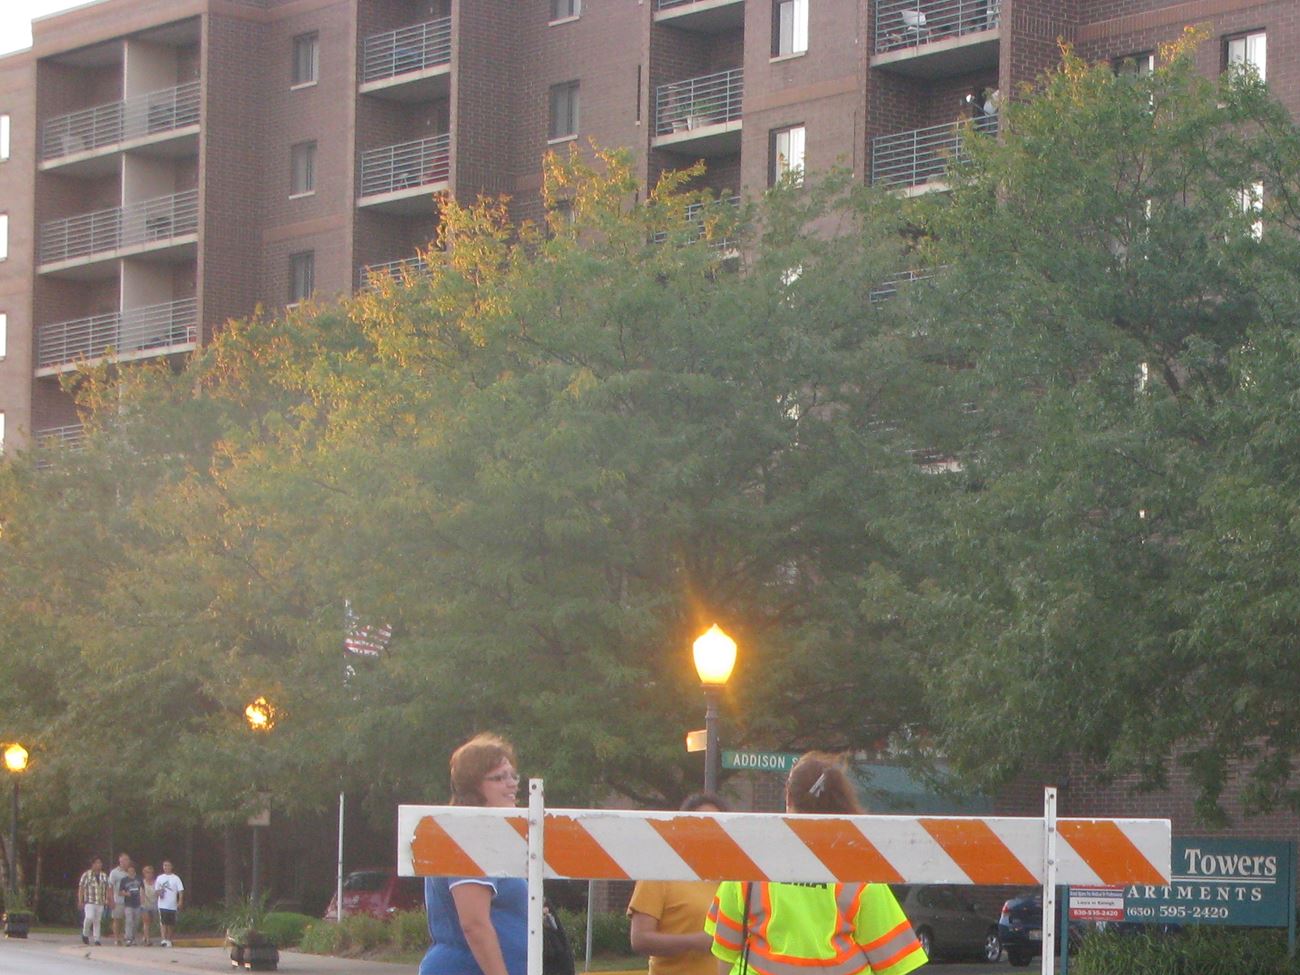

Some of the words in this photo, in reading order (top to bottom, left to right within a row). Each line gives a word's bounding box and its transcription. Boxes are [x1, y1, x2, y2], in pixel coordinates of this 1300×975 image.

[733, 754, 785, 768] ADDISON
[1184, 848, 1277, 876] Towers
[1126, 885, 1262, 901] ARTMENTS
[1159, 906, 1228, 919] 595-2420
